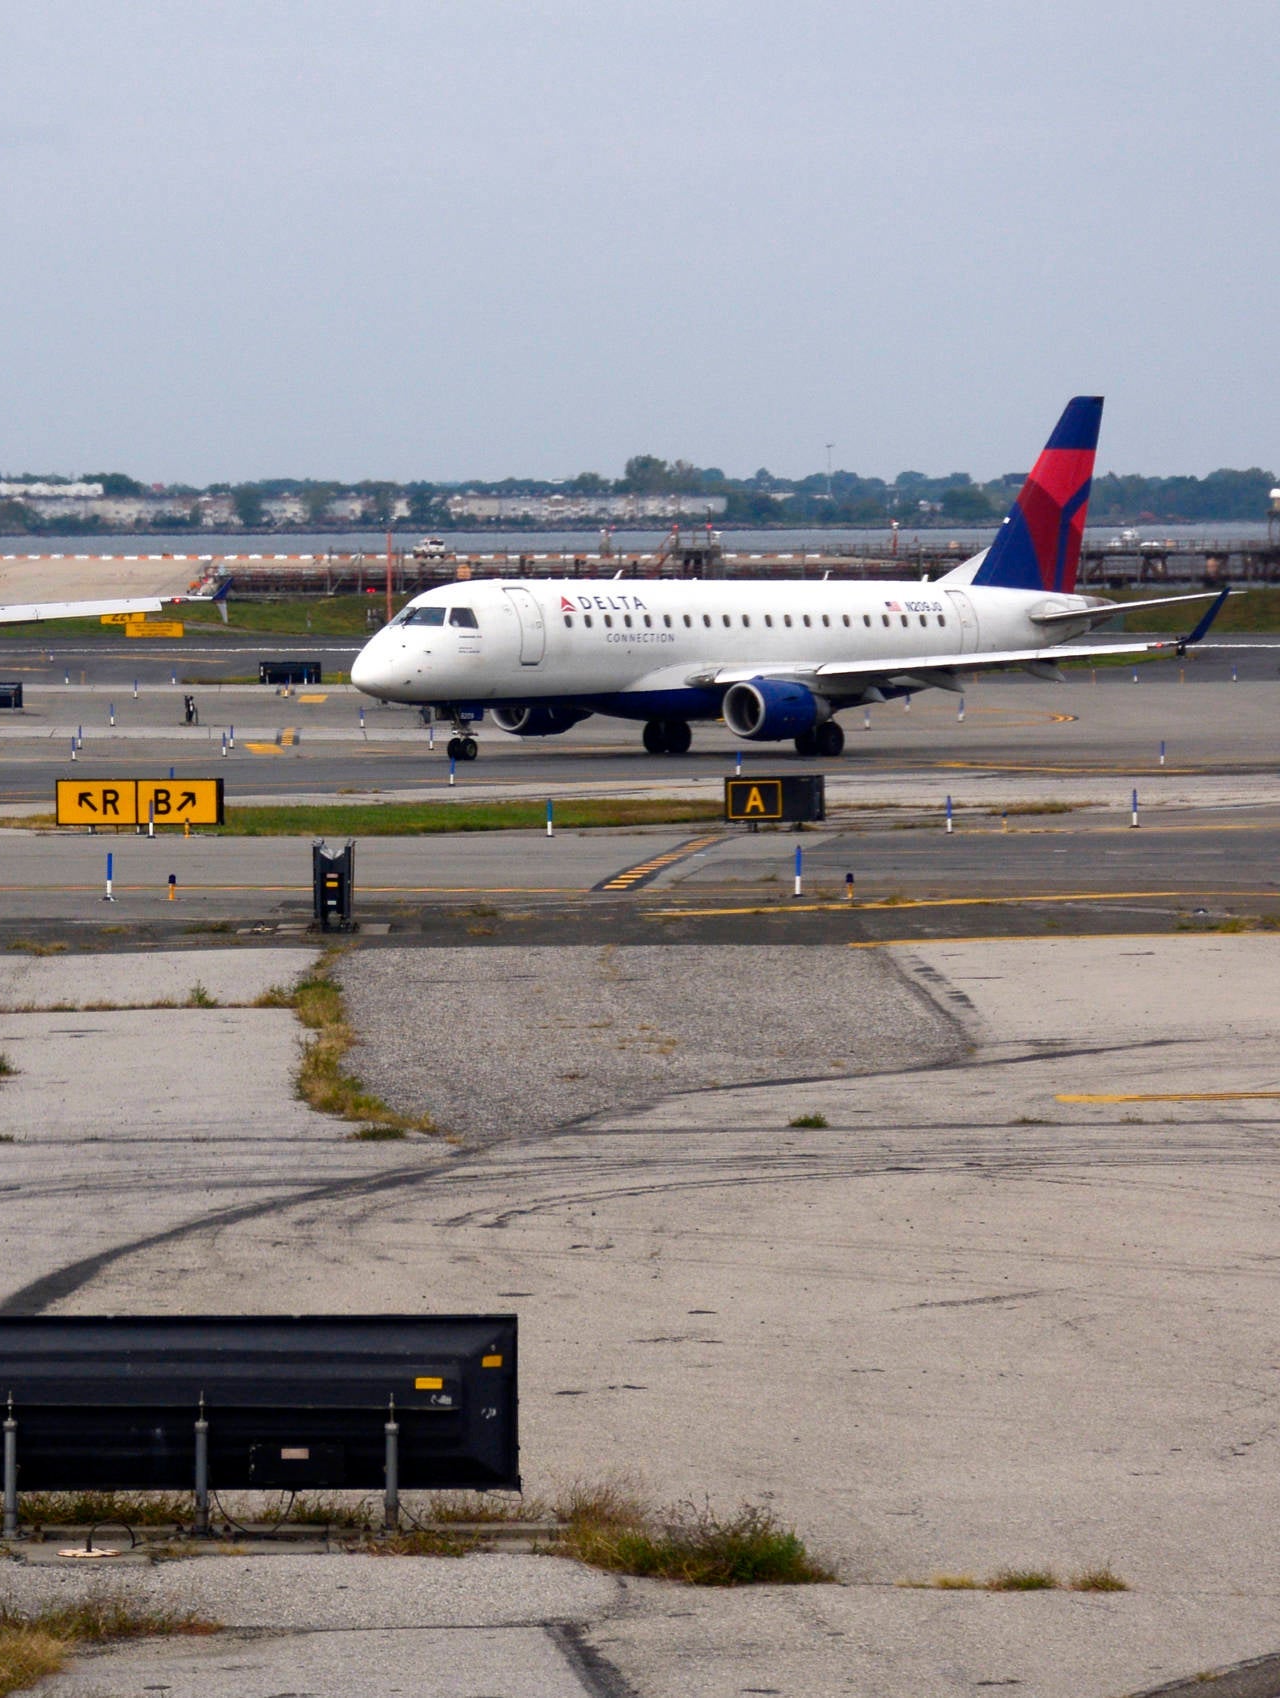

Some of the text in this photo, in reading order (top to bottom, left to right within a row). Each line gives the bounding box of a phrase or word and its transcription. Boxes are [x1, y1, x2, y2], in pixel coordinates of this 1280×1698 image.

[577, 596, 648, 610] DELTA
[606, 633, 675, 643] CONNECTION
[102, 789, 171, 815] R B
[744, 786, 765, 813] A
